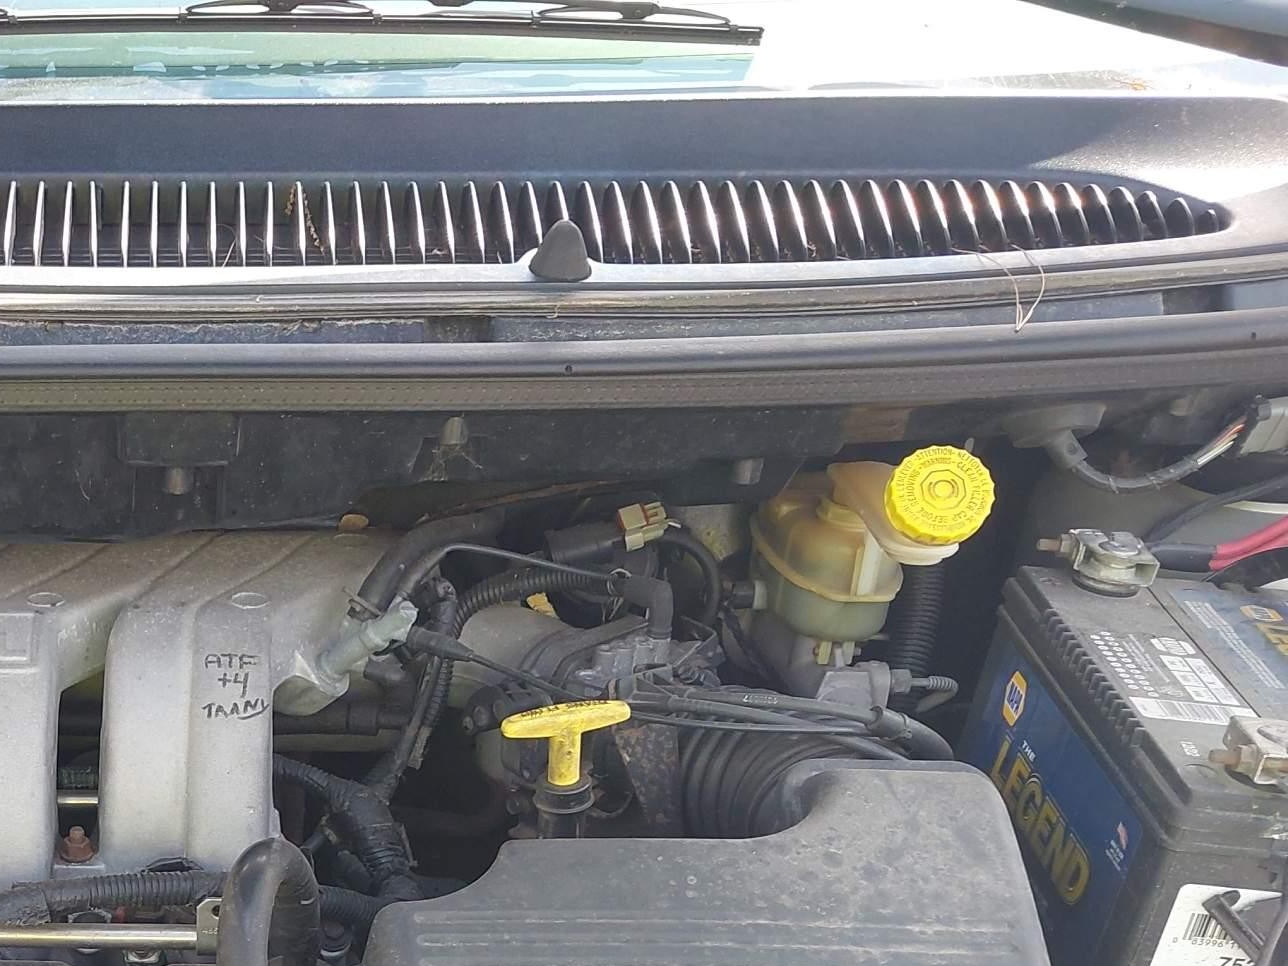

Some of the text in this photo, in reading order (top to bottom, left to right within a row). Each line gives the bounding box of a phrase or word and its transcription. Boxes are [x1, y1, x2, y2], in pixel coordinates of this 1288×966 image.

[205, 652, 261, 669] ATF
[217, 672, 249, 698] +4
[1020, 740, 1037, 763] THE
[990, 735, 1091, 905] LEGEND
